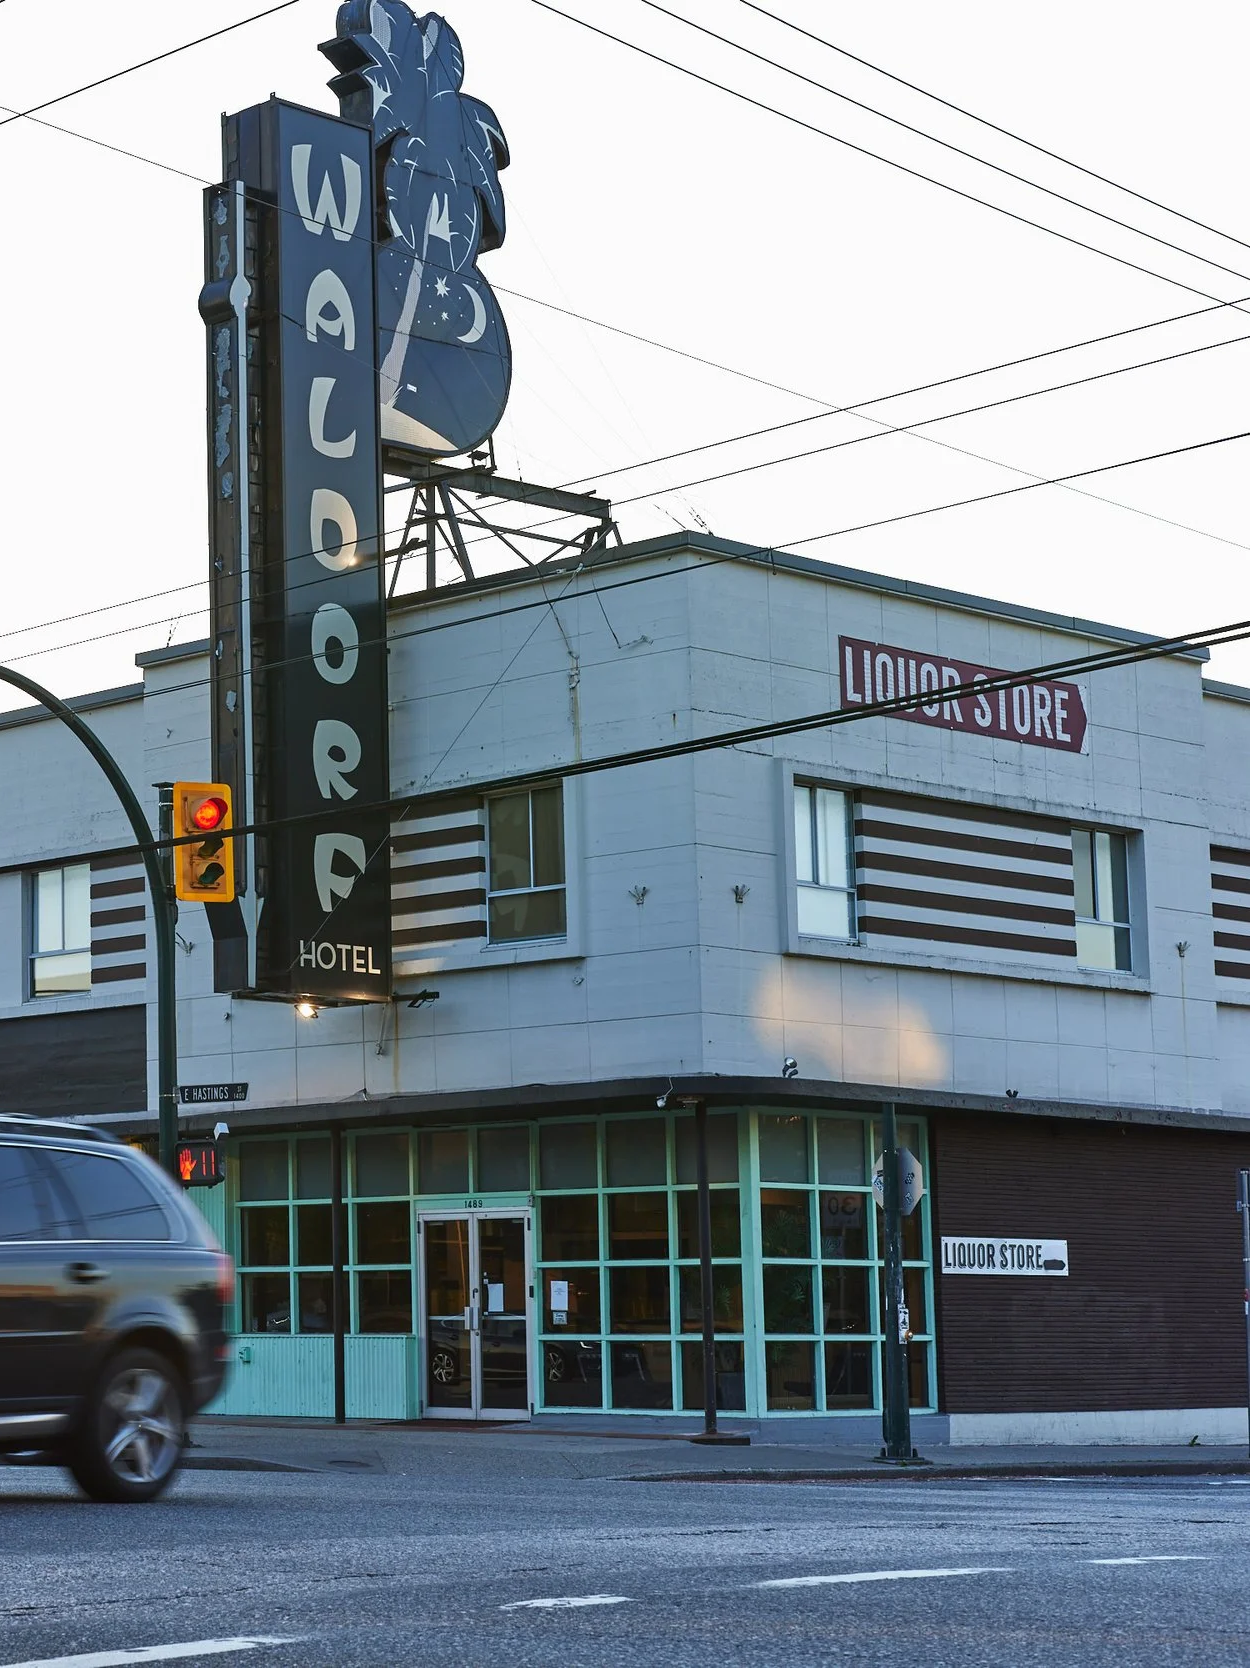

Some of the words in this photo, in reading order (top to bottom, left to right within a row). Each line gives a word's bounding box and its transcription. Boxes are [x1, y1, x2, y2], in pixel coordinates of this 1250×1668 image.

[291, 143, 367, 913] WALDORF
[845, 645, 964, 724] LIQUOR
[973, 673, 1072, 743] STORE
[299, 939, 381, 975] HOTEL
[184, 1088, 190, 1101] E
[192, 1086, 229, 1101] HASTINGS
[202, 1149, 216, 1177] 11
[464, 1199, 483, 1209] 1489
[943, 1242, 997, 1270] LIQUOR
[999, 1243, 1043, 1271] STORE
